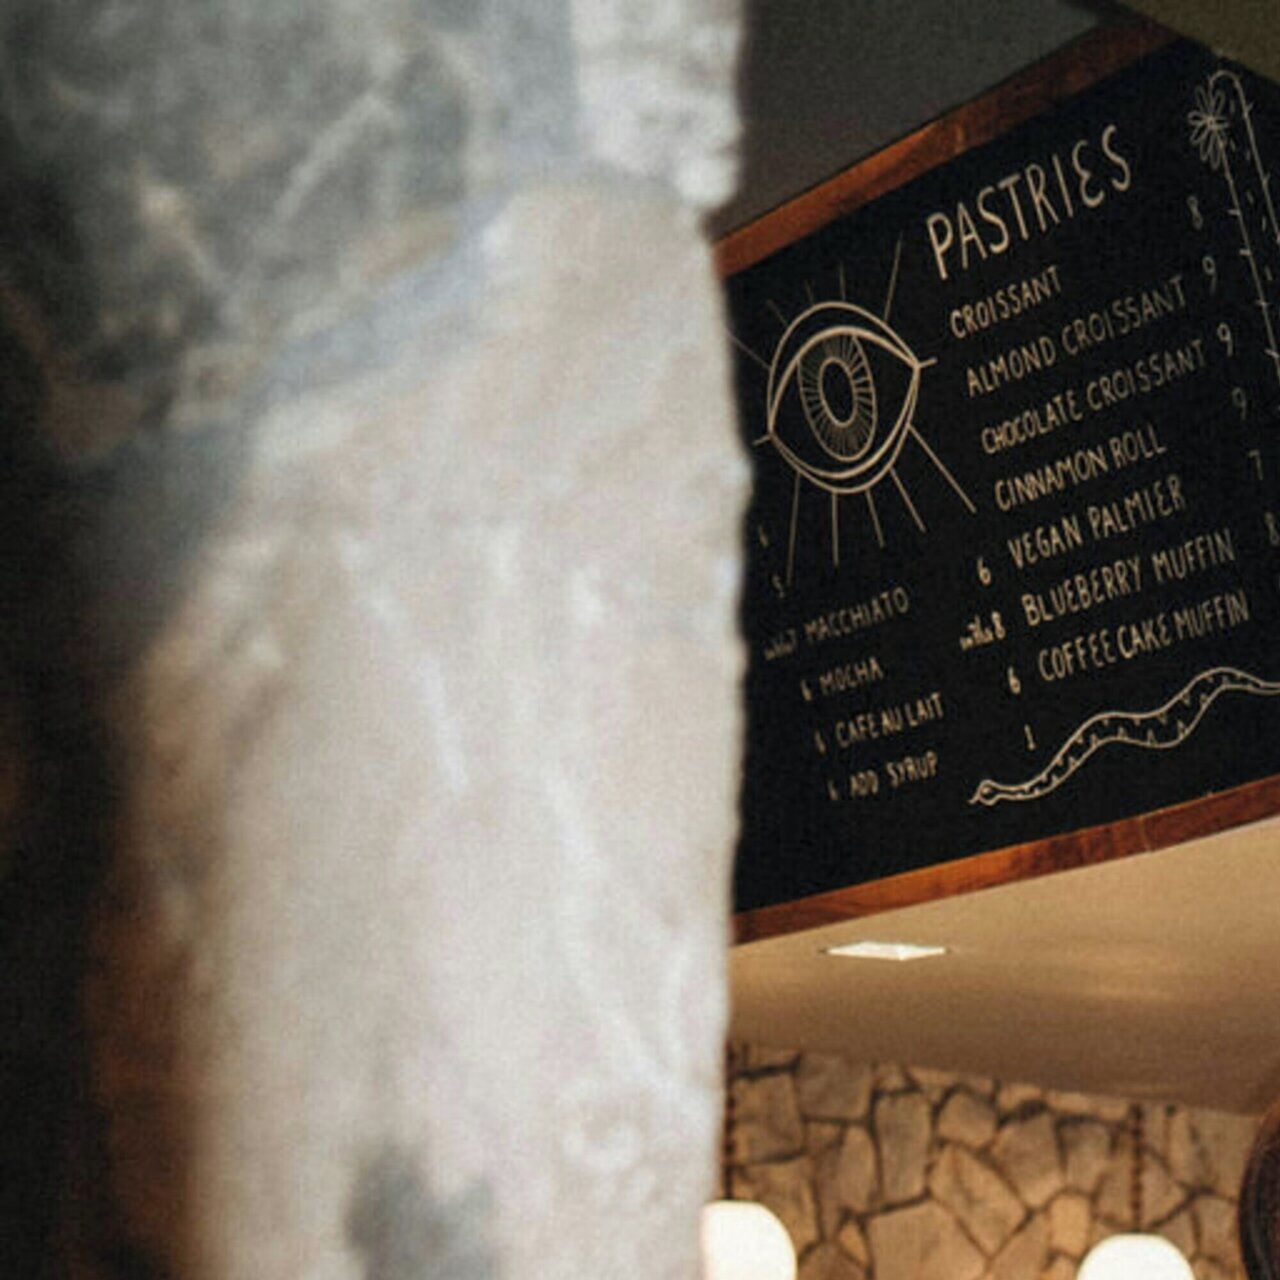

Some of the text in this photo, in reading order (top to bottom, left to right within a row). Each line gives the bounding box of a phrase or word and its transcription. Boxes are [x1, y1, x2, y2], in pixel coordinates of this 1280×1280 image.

[927, 124, 1131, 281] PASTRIES
[951, 265, 1063, 339] CROISSANT
[966, 336, 1057, 398] ALMOND
[1061, 274, 1187, 356] CROISSANT
[981, 390, 1083, 455] CHOCOLATE
[1086, 338, 1206, 411] CROISSANT
[994, 445, 1109, 512] CINNAMON
[1110, 423, 1167, 470] ROLL
[1006, 514, 1083, 570] VEGAN
[1086, 473, 1187, 541] PALMIER
[976, 555, 992, 586] 6
[1020, 554, 1143, 627] BLUEBERRY
[1152, 527, 1237, 583] MUFFIN
[1037, 629, 1117, 683] COFFEE
[1117, 613, 1173, 660] CAKE
[1173, 589, 1250, 642] MUFFIN
